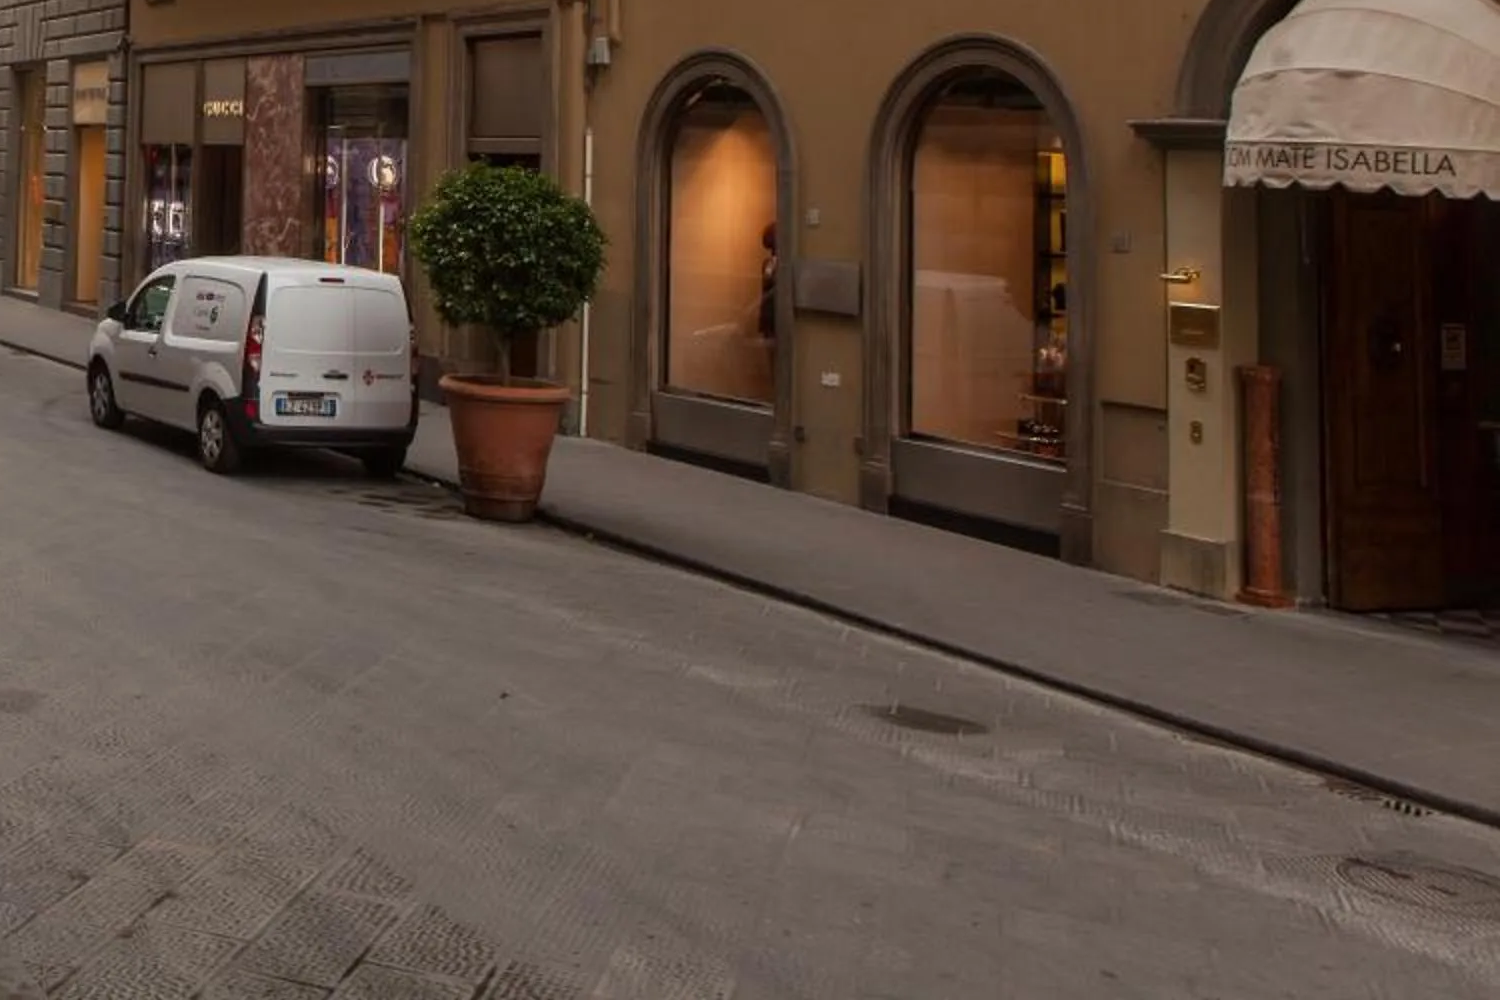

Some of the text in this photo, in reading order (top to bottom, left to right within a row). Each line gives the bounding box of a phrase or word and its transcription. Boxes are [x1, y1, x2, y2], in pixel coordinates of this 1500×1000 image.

[203, 101, 243, 117] GUCCI
[1256, 146, 1315, 169] MATE
[1326, 147, 1457, 177] ISABELLA
